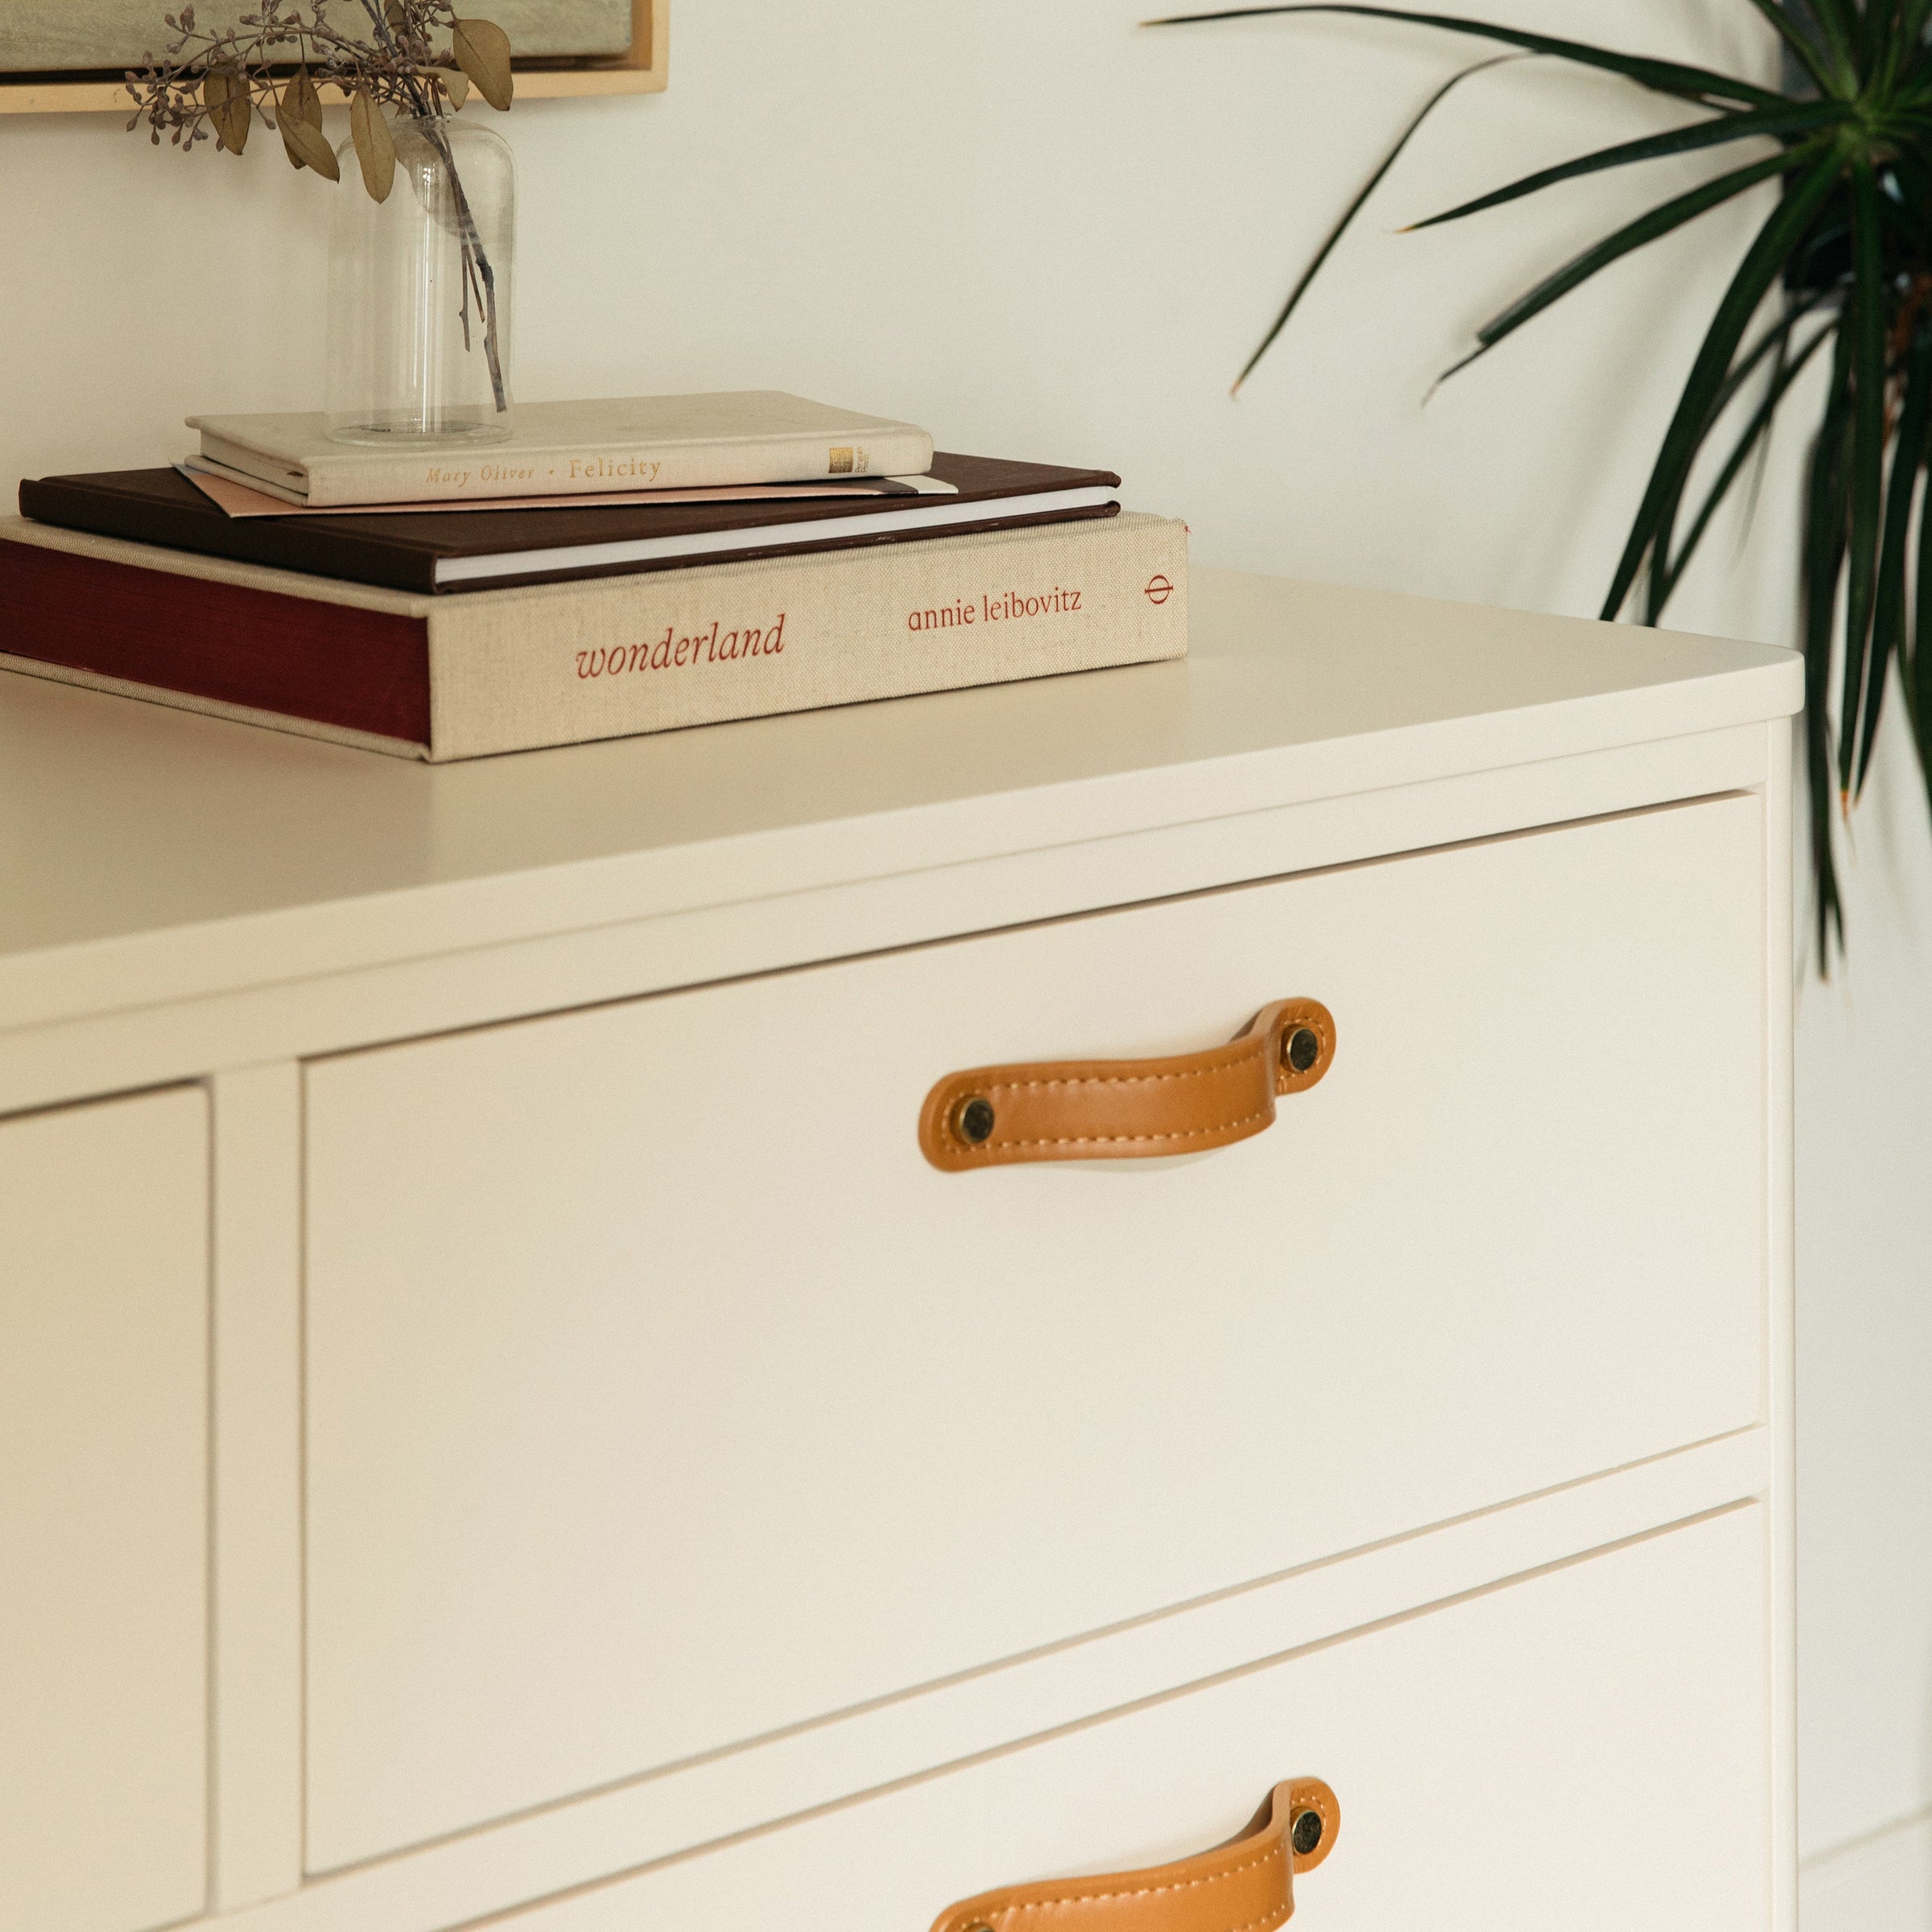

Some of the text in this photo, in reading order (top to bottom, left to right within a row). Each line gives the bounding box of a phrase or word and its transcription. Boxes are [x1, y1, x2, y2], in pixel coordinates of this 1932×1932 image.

[426, 456, 662, 488] Mary Oliver Felicity
[907, 586, 1082, 631] annie leibovitz
[575, 613, 786, 679] wonderland
